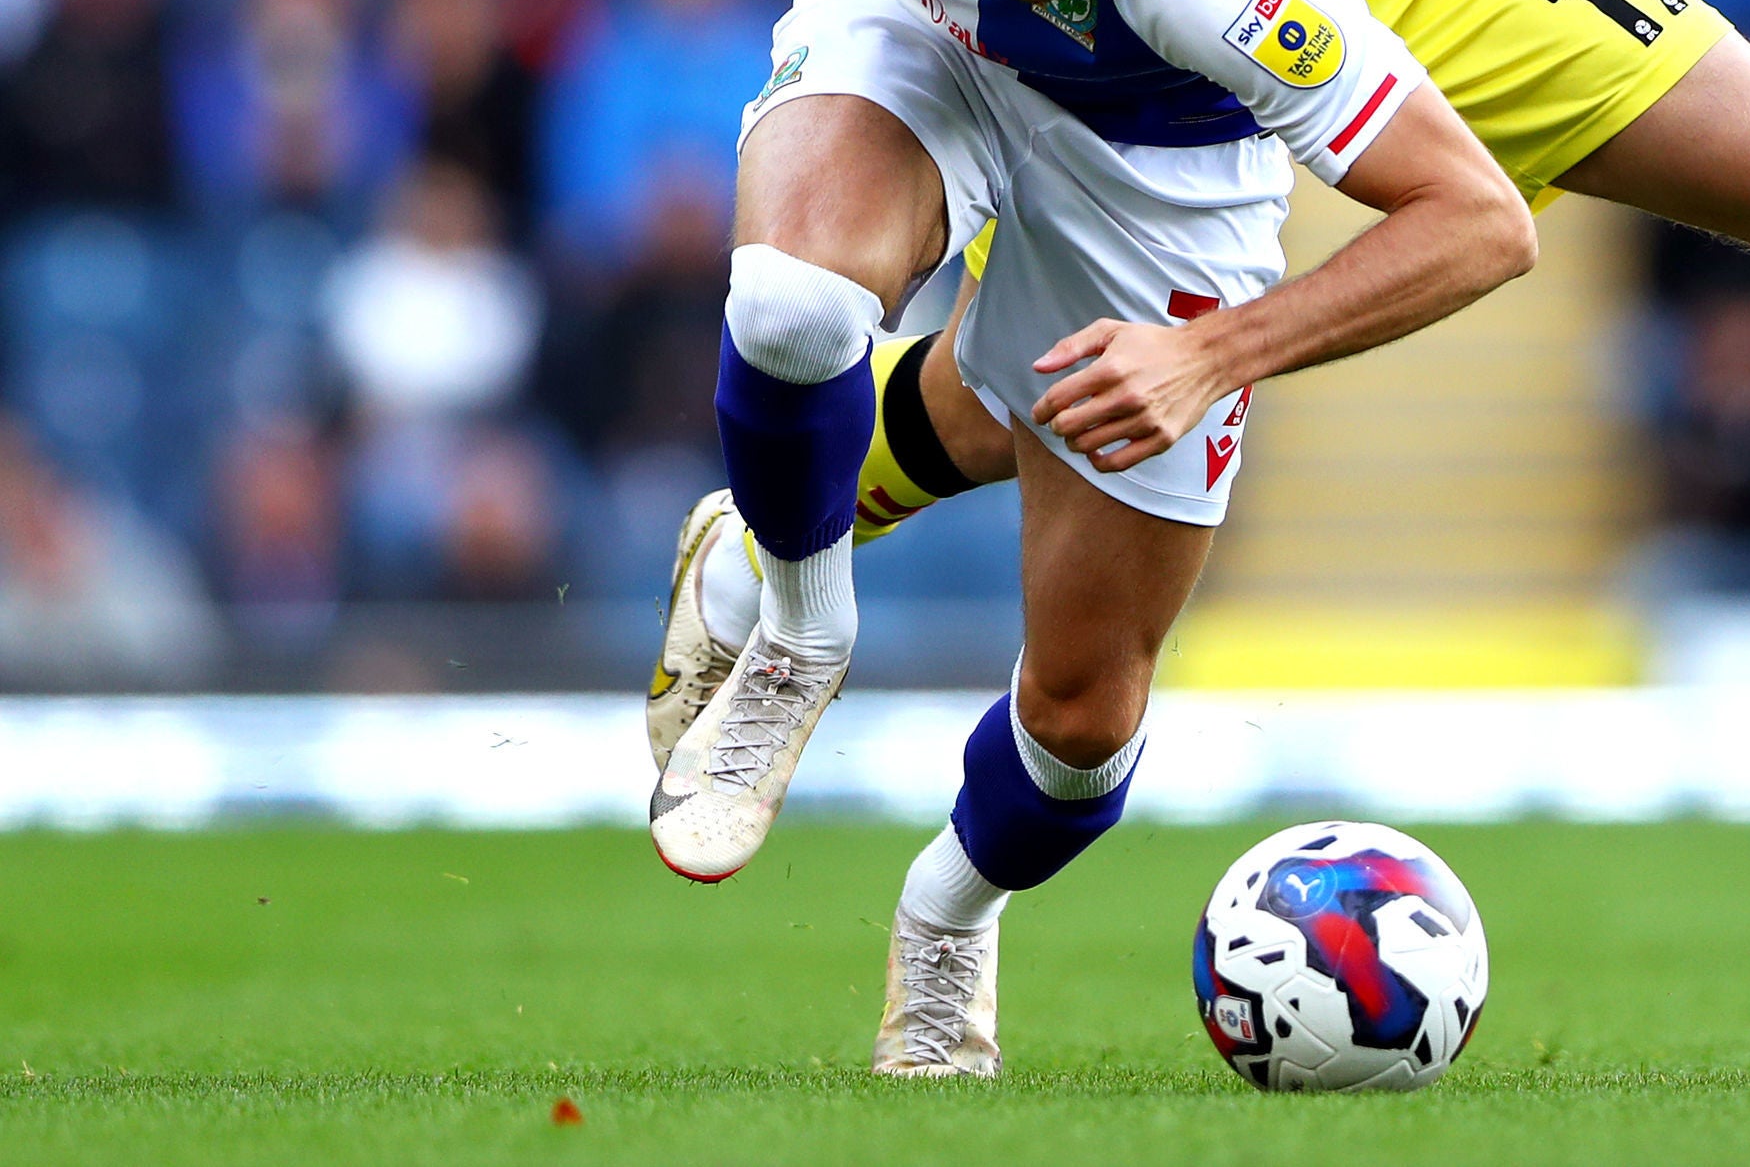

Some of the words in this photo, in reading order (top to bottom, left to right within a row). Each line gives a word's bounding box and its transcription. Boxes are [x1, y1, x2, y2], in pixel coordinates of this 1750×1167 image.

[1238, 15, 1263, 46] sky
[1288, 49, 1311, 75] TAKE
[1308, 23, 1327, 48] TIME
[1298, 64, 1313, 78] TO
[1310, 31, 1335, 64] THINK
